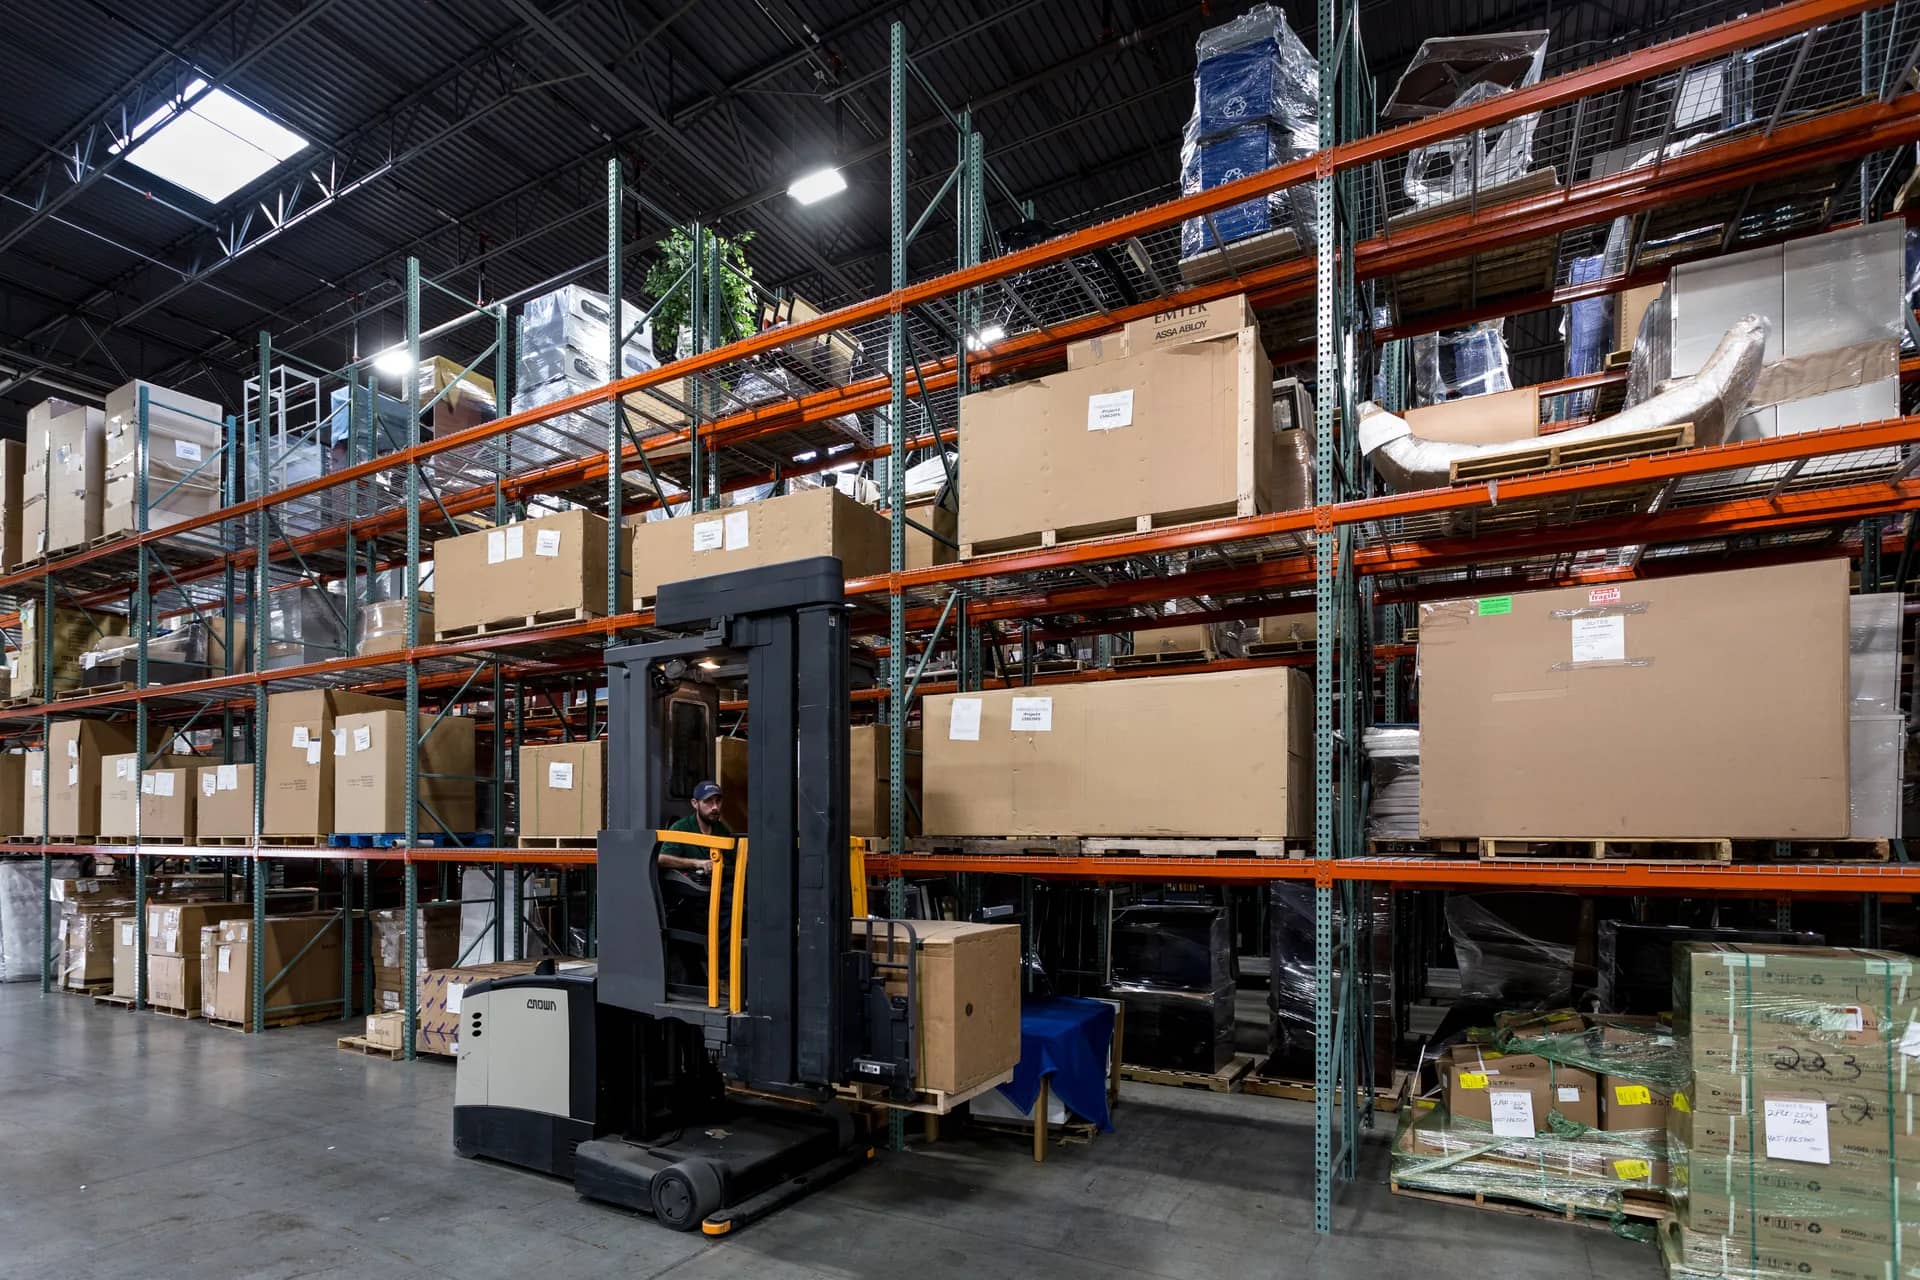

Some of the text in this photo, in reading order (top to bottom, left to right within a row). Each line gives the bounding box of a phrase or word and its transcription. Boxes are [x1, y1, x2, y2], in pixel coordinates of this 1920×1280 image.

[1155, 320, 1207, 340] ASSA ABLOY
[526, 998, 557, 1011] CROWN
